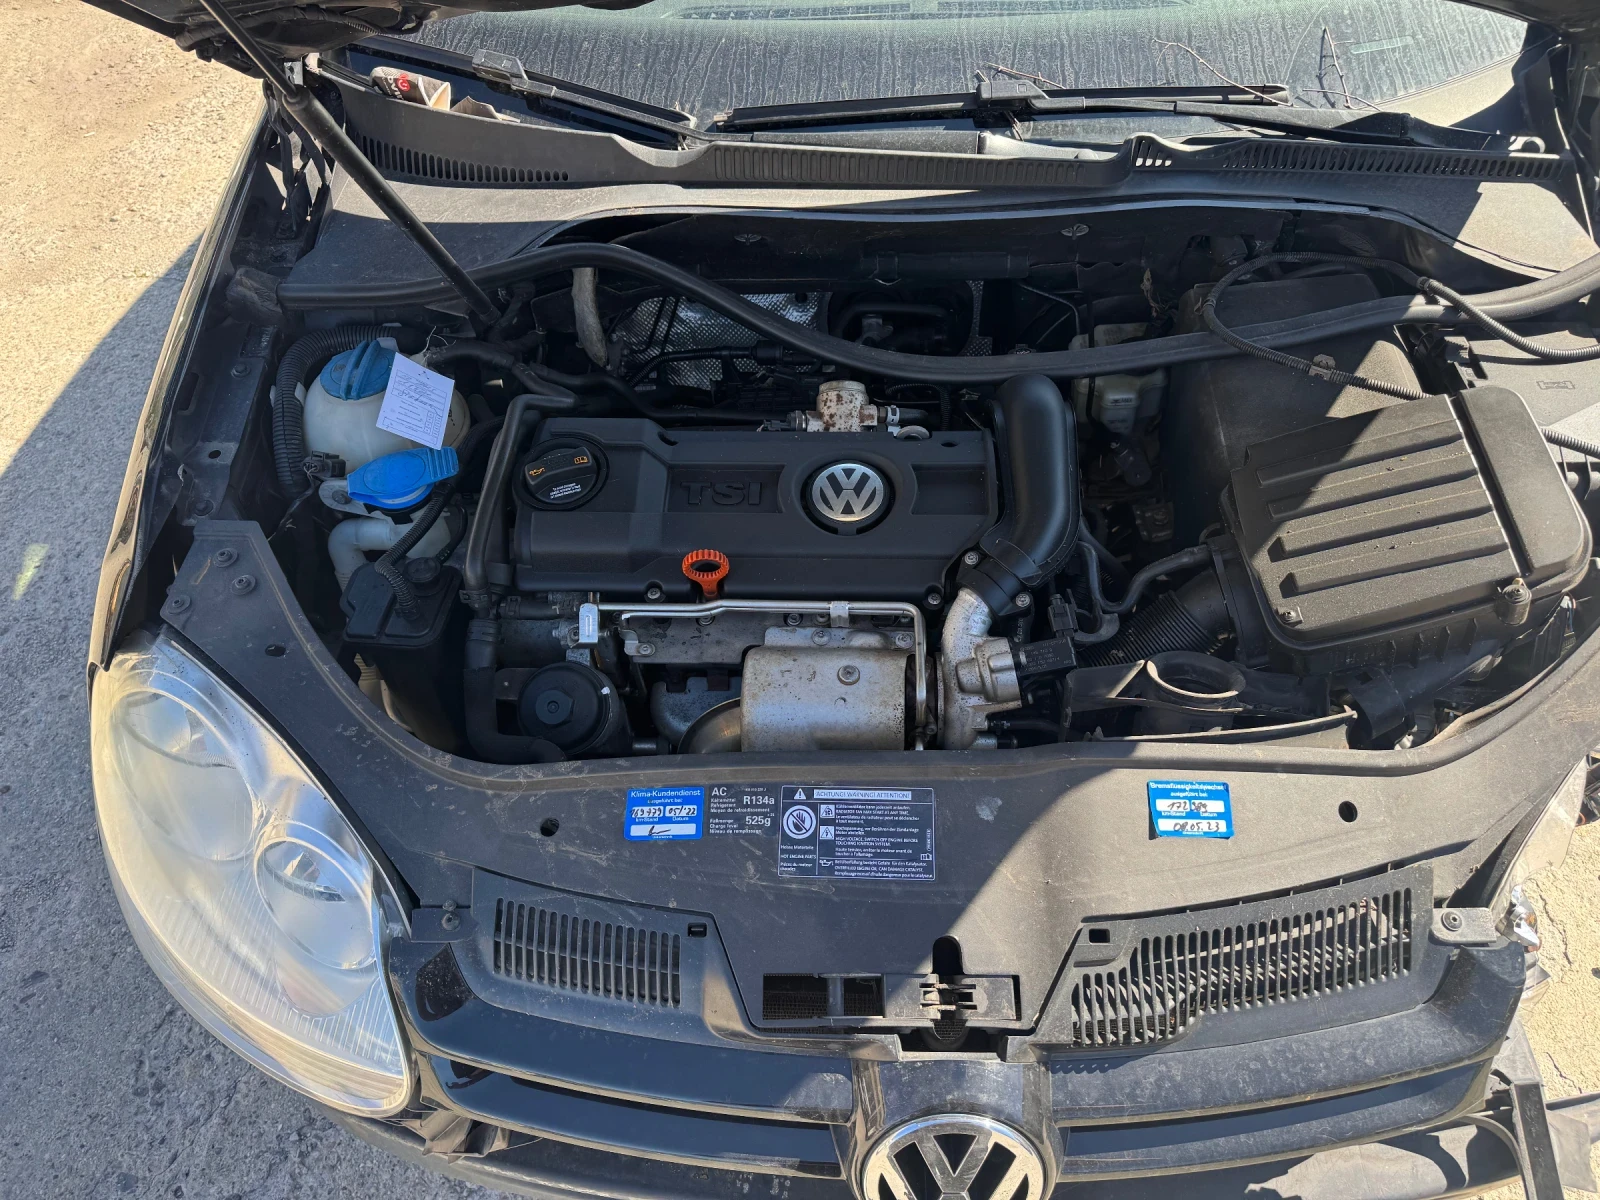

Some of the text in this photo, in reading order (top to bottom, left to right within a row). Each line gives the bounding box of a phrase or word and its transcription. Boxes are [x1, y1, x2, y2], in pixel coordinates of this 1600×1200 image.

[681, 481, 762, 505] TSI
[711, 787, 727, 796] AC
[743, 795, 775, 805] R134a
[745, 815, 771, 827] 525g
